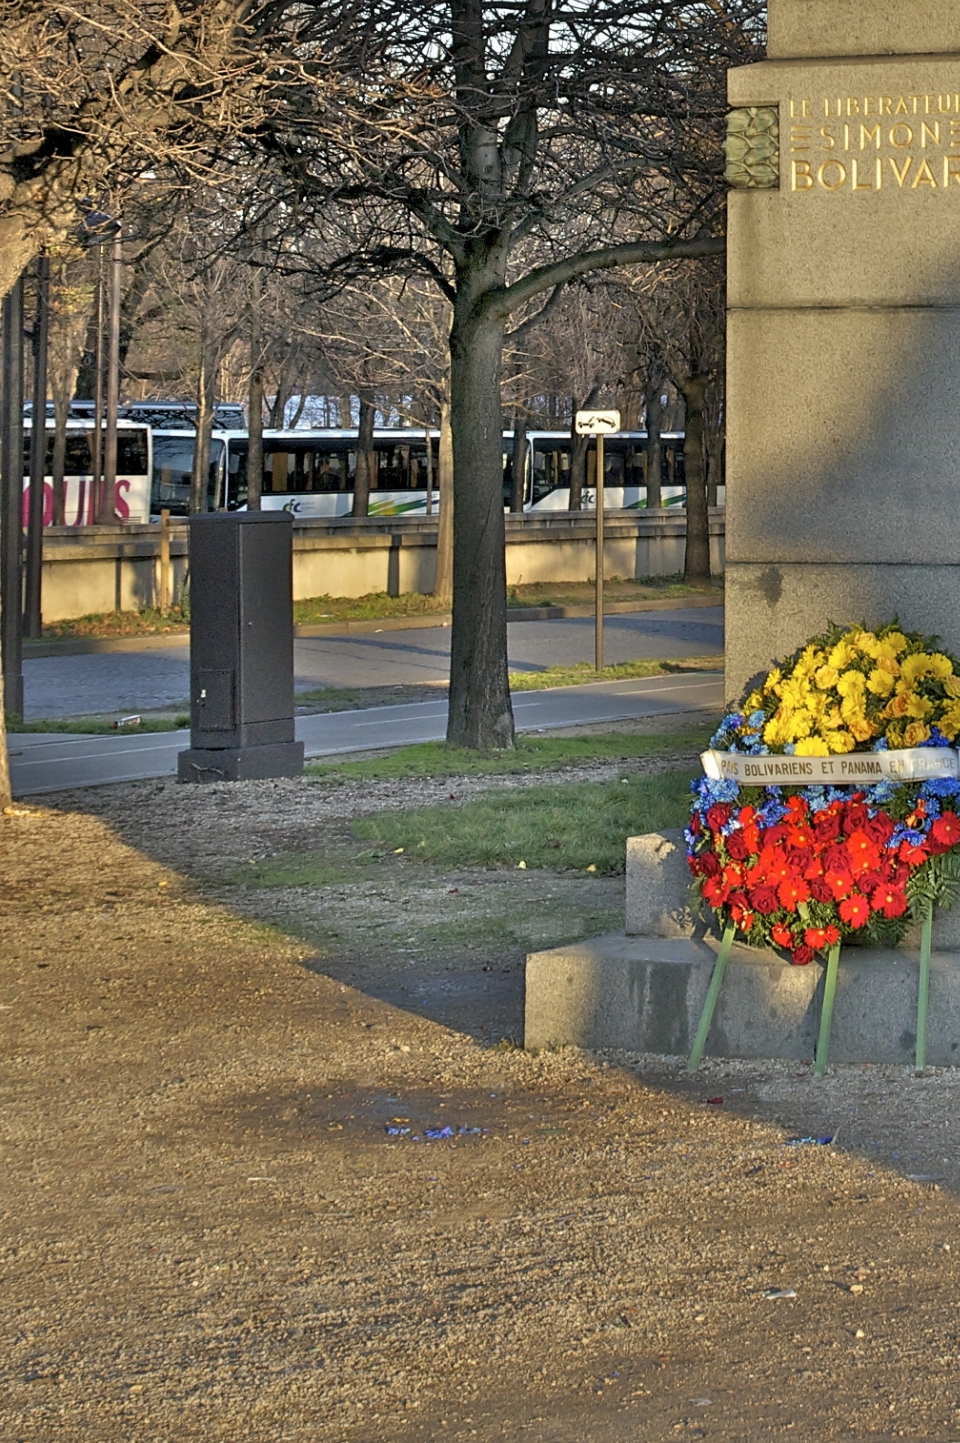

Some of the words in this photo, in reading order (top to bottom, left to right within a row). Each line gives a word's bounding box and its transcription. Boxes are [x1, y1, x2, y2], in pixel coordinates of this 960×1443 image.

[789, 99, 812, 118] LE
[819, 121, 942, 152] SIMON
[745, 760, 814, 776] BOLIVARIENS
[821, 761, 835, 775] ET
[841, 759, 883, 775] PANAMA
